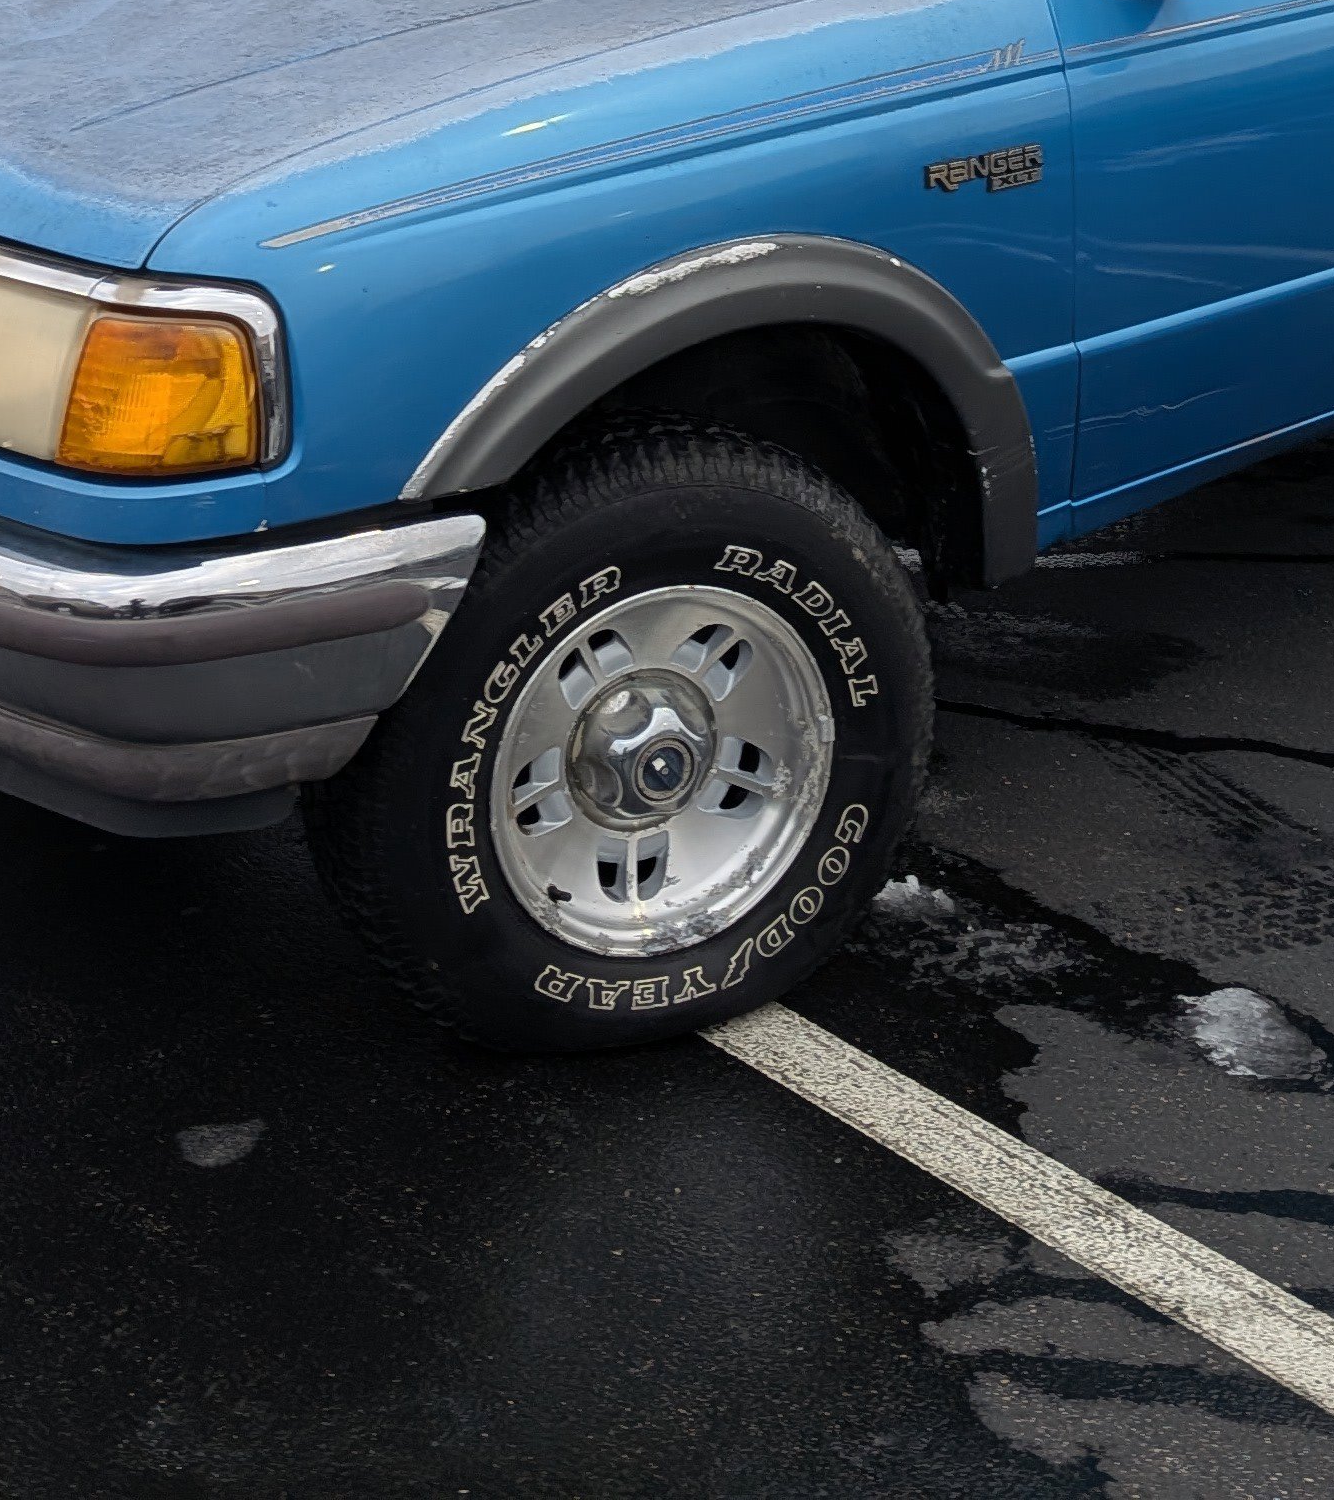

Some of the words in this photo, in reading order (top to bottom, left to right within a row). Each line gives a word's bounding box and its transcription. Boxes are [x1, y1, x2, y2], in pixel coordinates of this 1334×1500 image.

[997, 170, 1036, 188] XLT
[714, 544, 883, 708] RADIAL
[445, 565, 622, 914] WRANGLER
